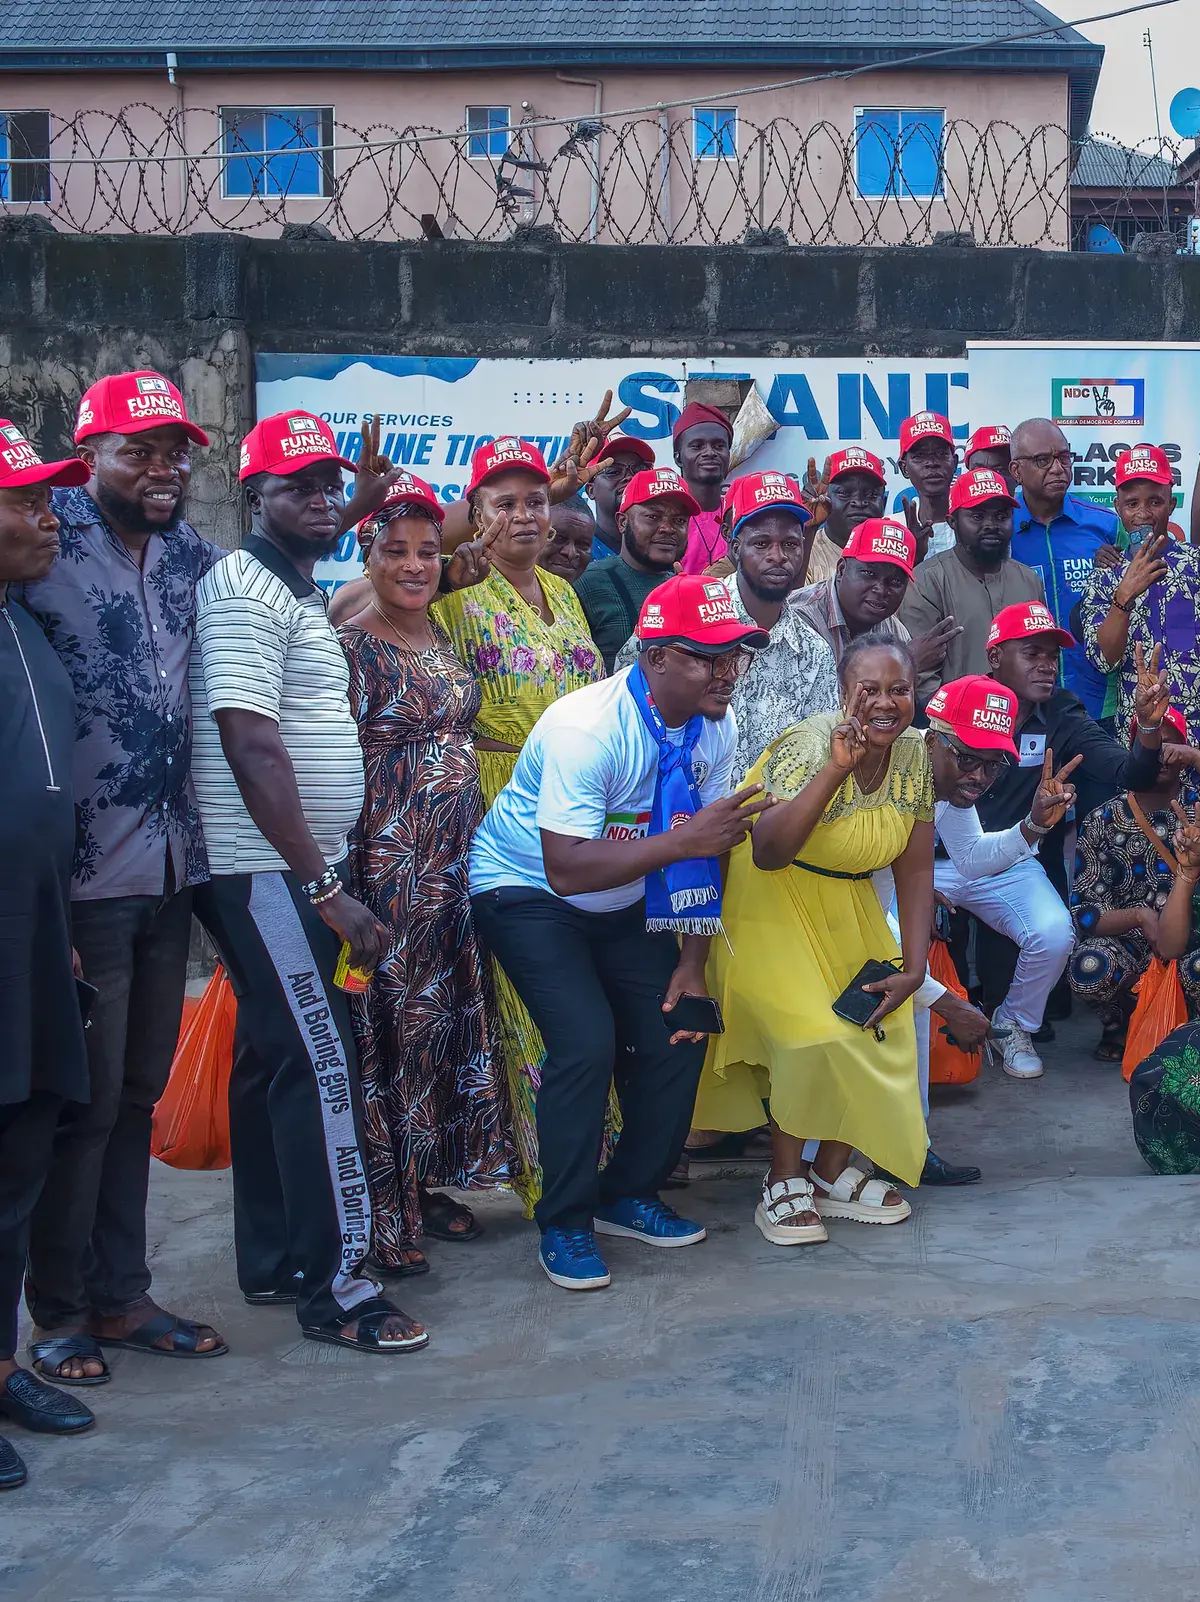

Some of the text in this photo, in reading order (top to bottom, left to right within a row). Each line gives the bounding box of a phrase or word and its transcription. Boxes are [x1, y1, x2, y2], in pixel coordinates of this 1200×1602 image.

[1064, 388, 1090, 398] NDC
[127, 395, 181, 412] FUNSO
[320, 412, 453, 427] OUR SERVICES
[910, 420, 944, 434] FUNSO
[280, 433, 330, 451] FUNSO
[989, 434, 1010, 443] FUN
[2, 444, 38, 465] FUN
[486, 450, 533, 467] FUNSO
[838, 457, 874, 470] FUNSO
[1124, 459, 1158, 472] FUNSO
[648, 480, 685, 493] FUNSO
[755, 485, 795, 500] FUNSO
[969, 481, 1003, 495] FUNSO
[872, 538, 909, 556] FUNSO
[1063, 558, 1093, 571] FUN
[973, 709, 1012, 728] FUNSO
[287, 970, 350, 1115] And Boring guys
[336, 1146, 364, 1182] And
[340, 1185, 371, 1245] Boring
